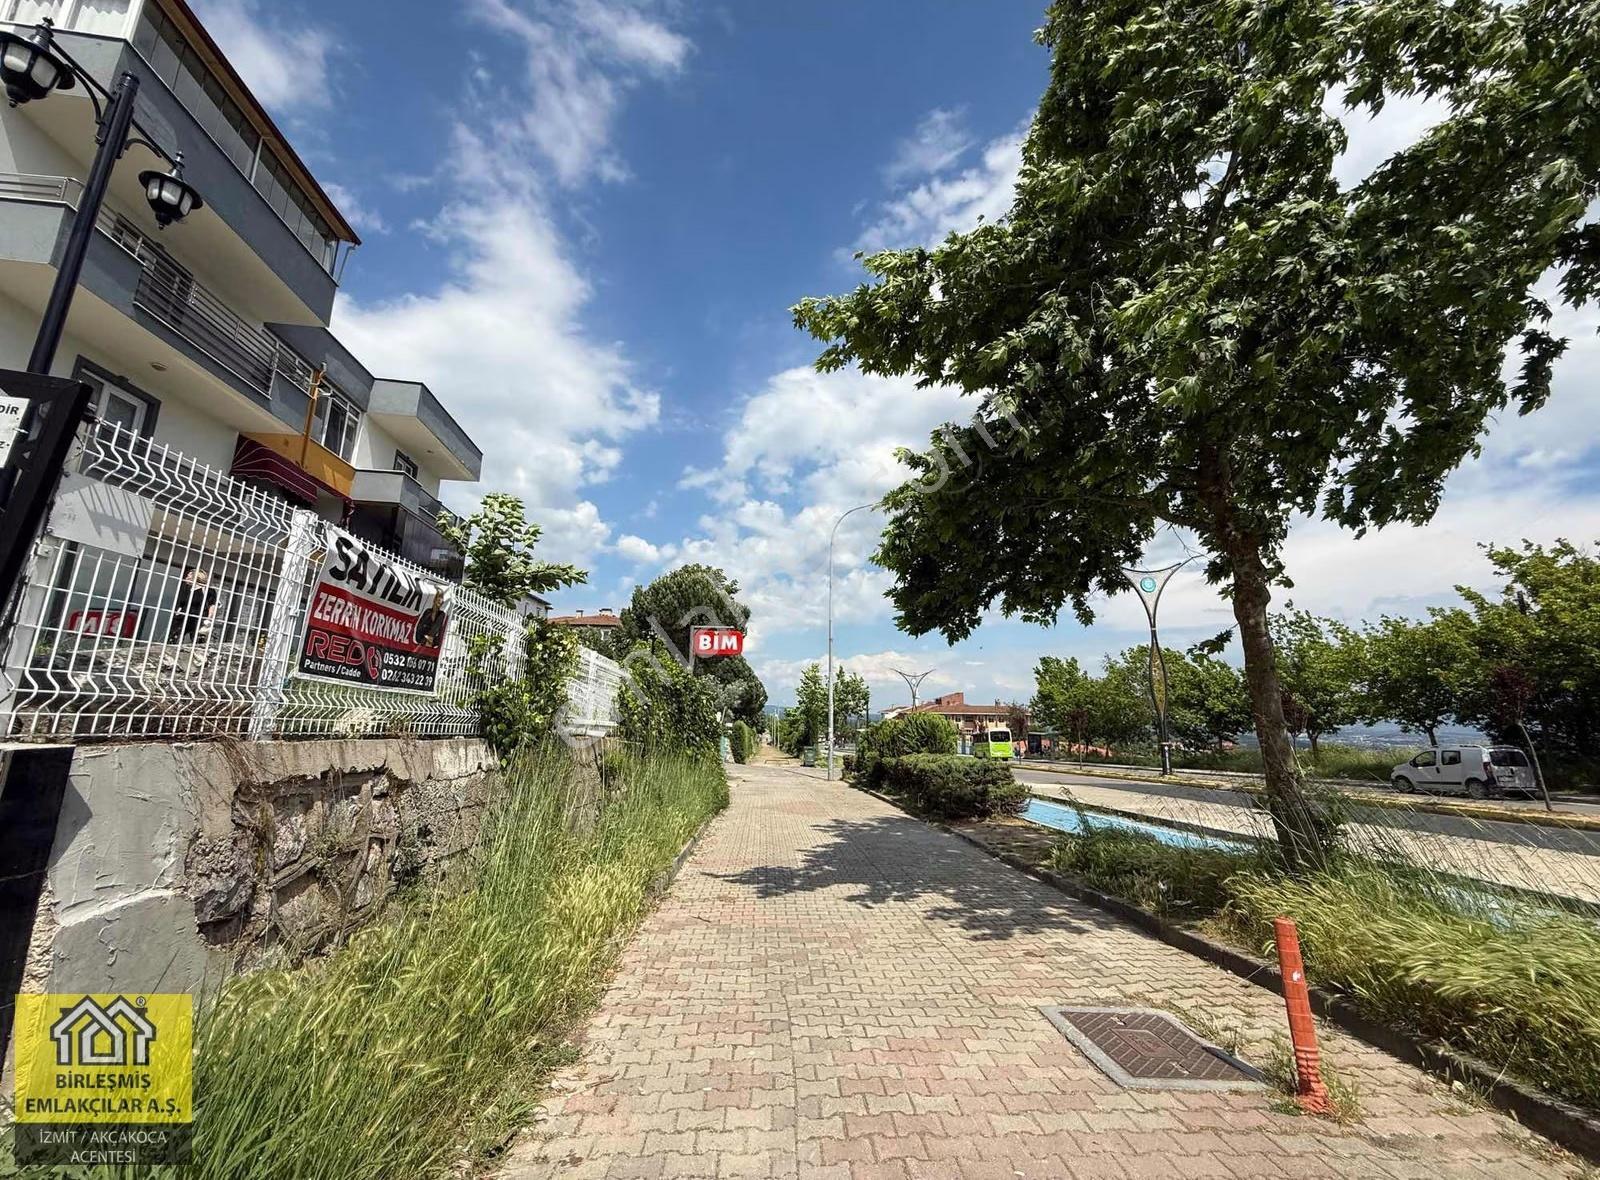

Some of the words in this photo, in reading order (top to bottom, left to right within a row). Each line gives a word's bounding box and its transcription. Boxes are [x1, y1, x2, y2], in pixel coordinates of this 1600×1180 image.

[360, 608, 413, 645] KORKMAZ
[698, 630, 739, 651] BİM
[303, 658, 336, 673] Partners
[383, 651, 406, 667] 0532
